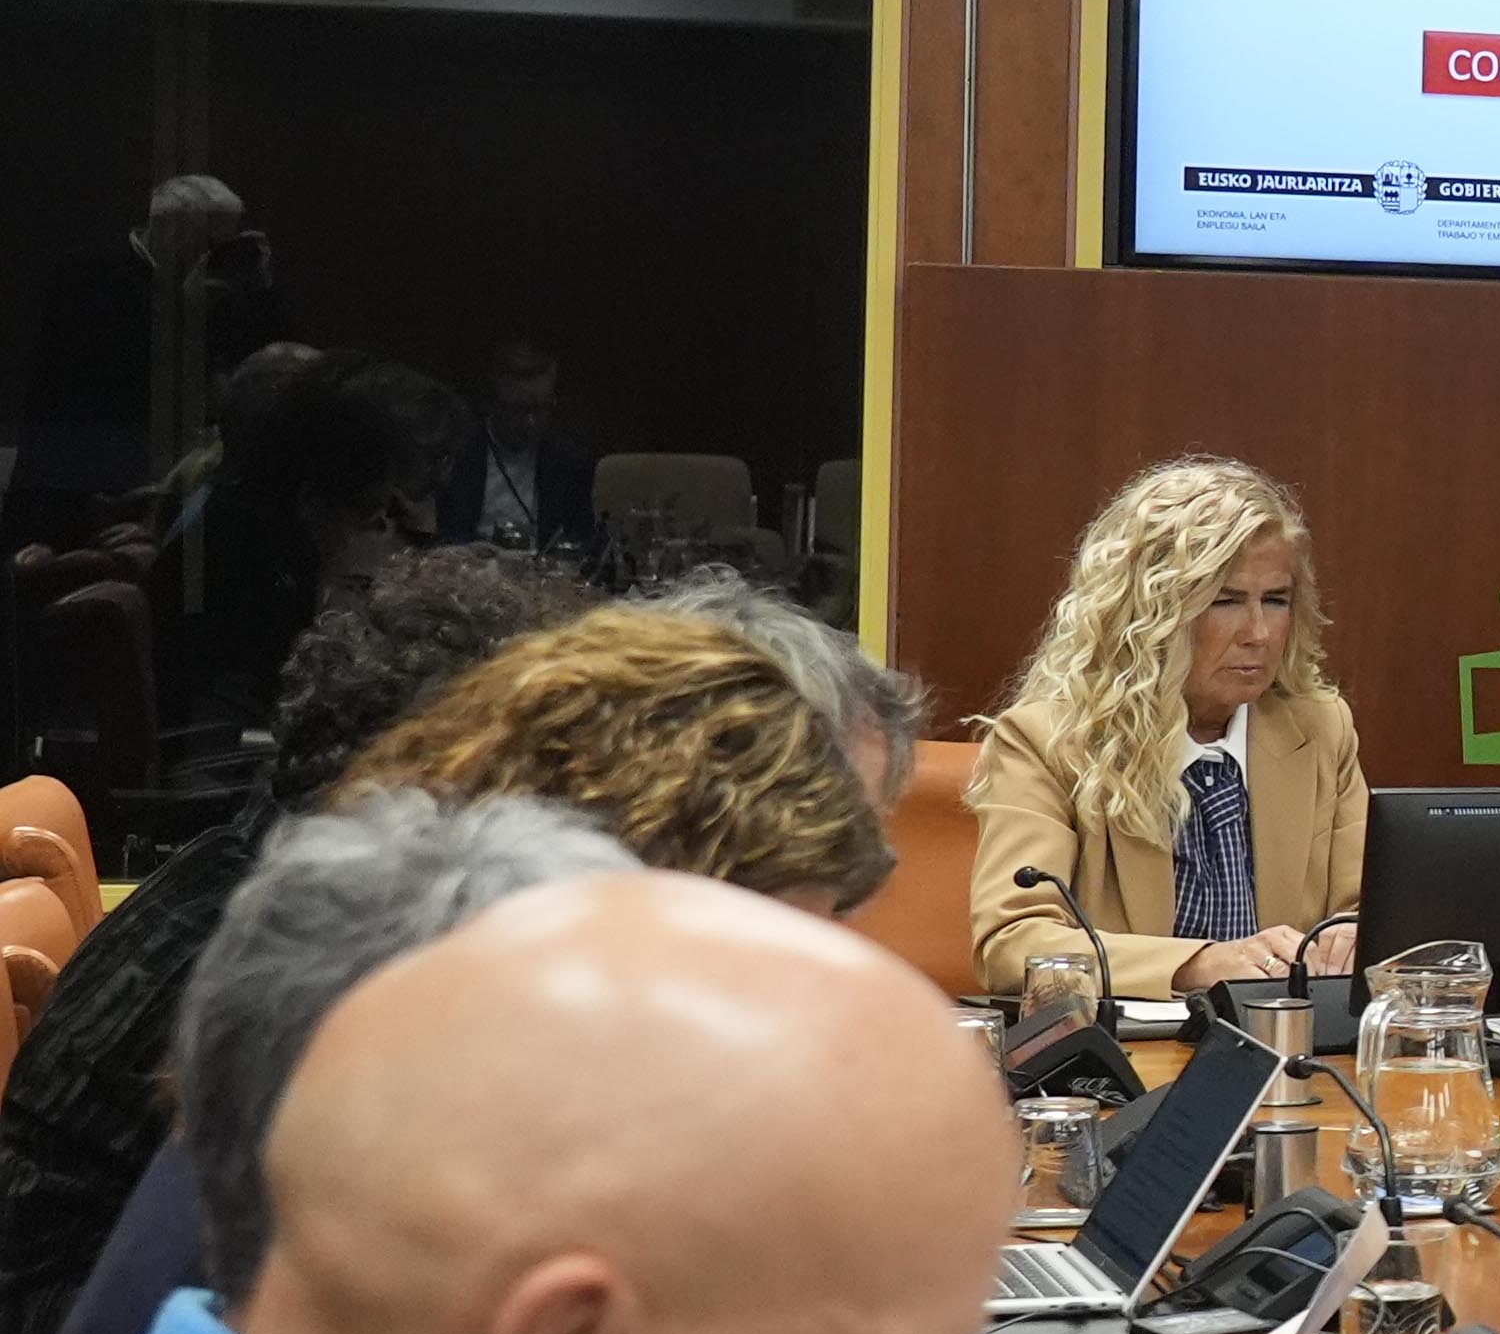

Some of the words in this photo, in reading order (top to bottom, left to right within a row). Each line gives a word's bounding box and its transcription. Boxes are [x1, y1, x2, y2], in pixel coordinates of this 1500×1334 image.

[1198, 172, 1252, 189] EUSKO
[1255, 174, 1363, 194] JAURLARITZA
[1269, 212, 1287, 220] ETA
[1438, 230, 1477, 240] TRABAJO
